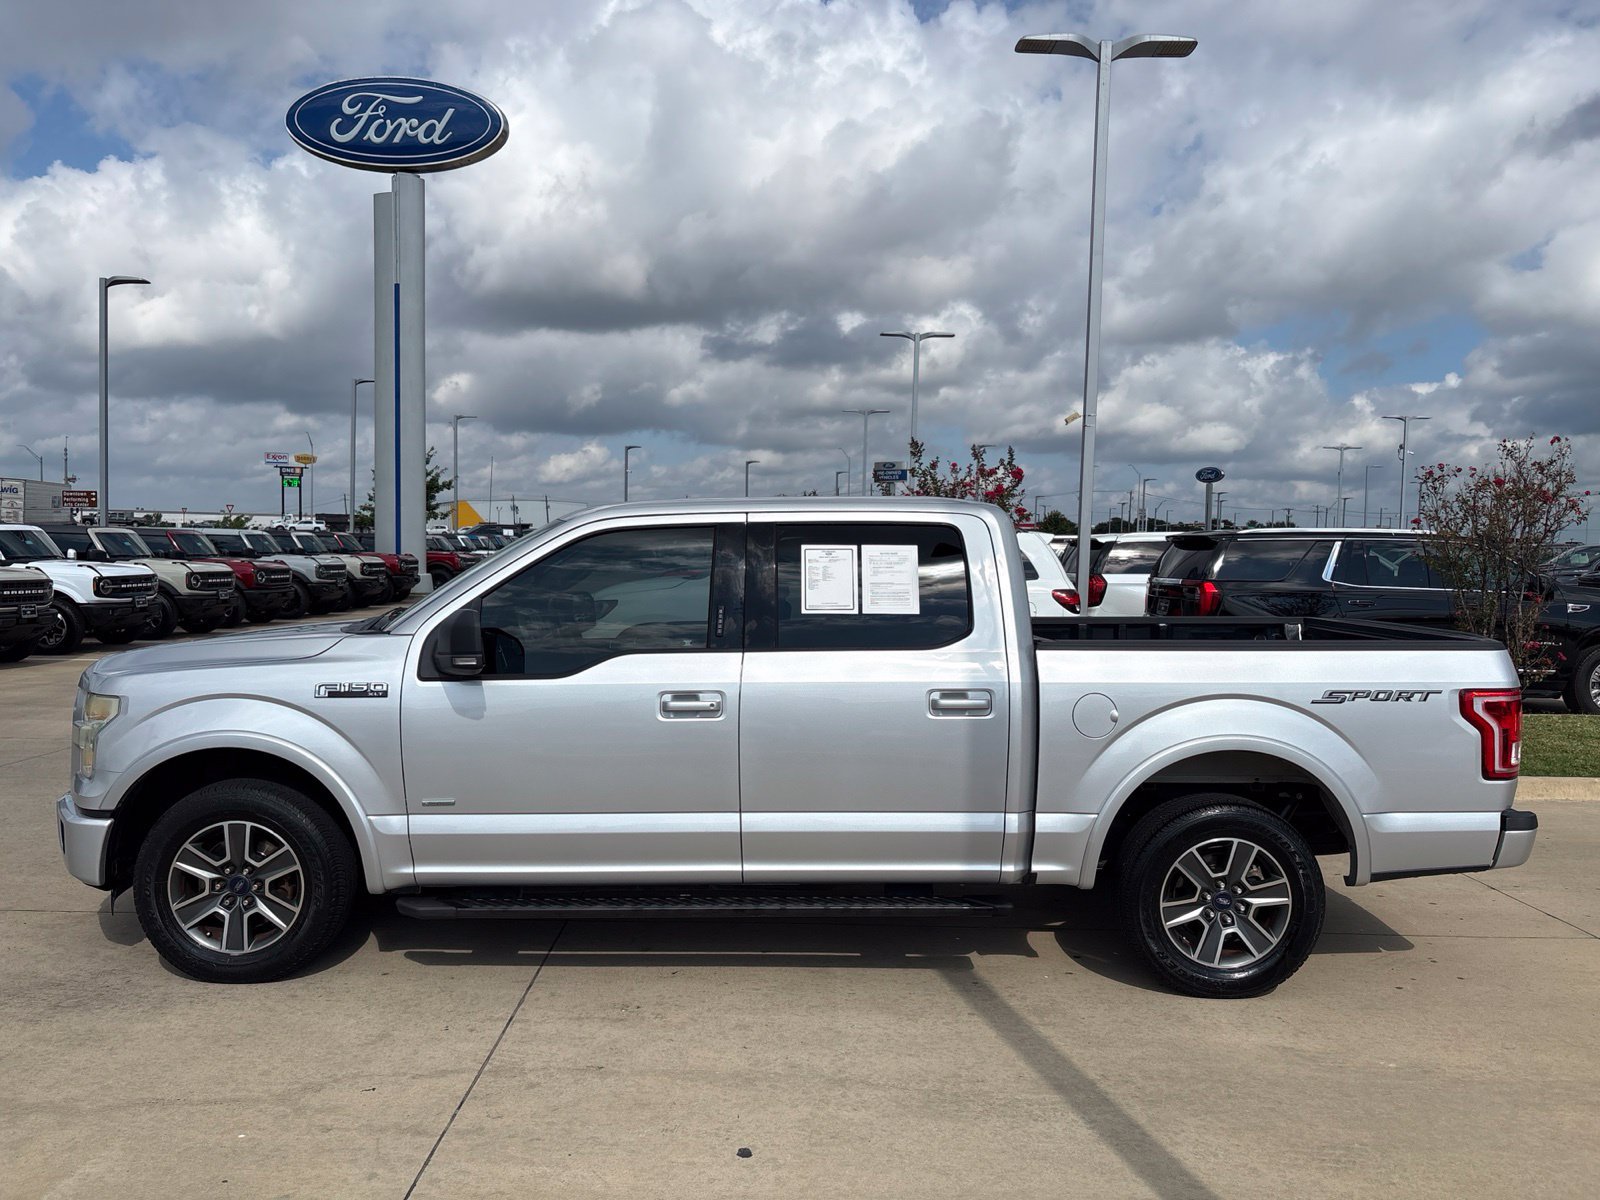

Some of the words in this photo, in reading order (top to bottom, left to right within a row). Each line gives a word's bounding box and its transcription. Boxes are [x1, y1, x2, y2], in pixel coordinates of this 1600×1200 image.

[329, 92, 455, 145] Ford
[266, 453, 288, 461] Exxon
[1310, 689, 1443, 705] SPORT
